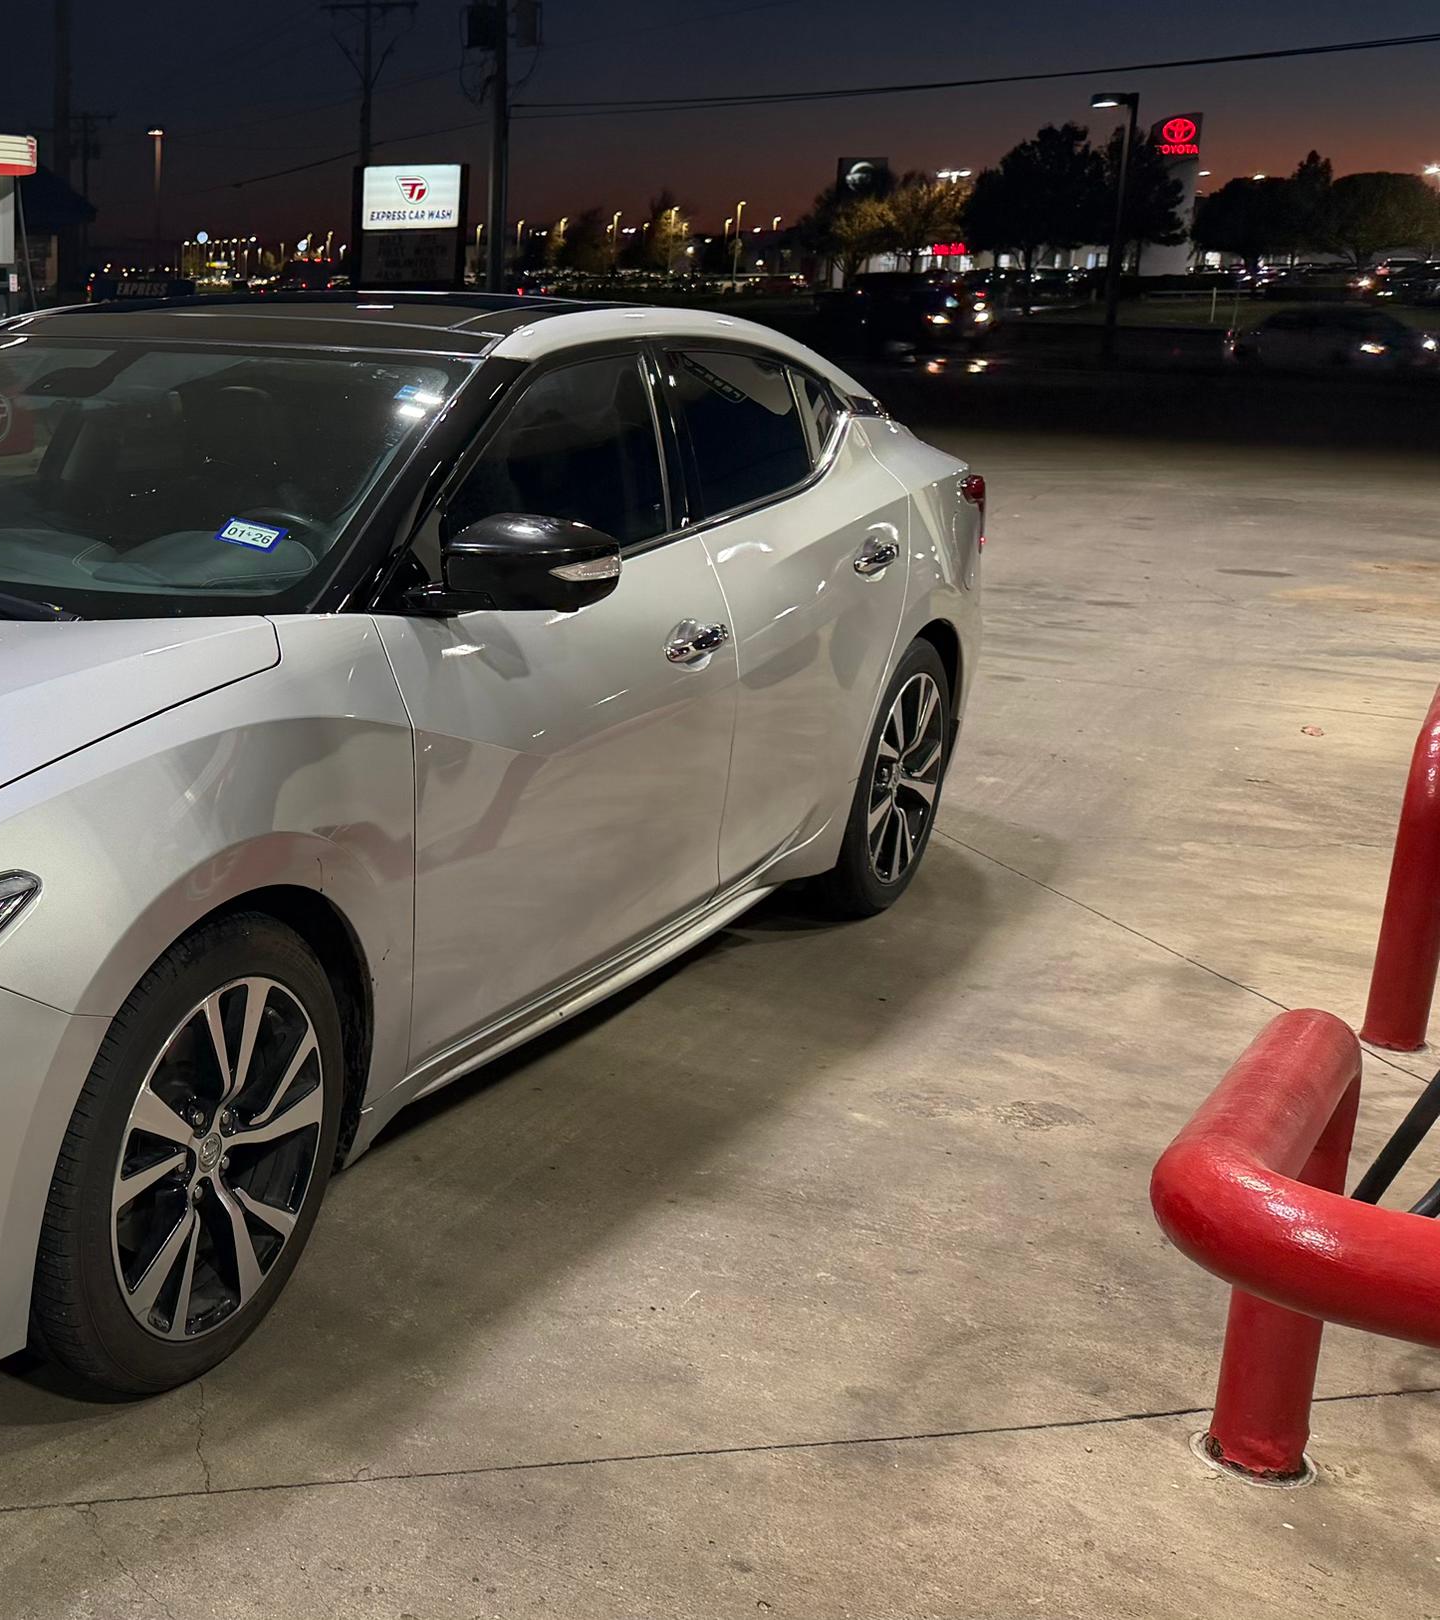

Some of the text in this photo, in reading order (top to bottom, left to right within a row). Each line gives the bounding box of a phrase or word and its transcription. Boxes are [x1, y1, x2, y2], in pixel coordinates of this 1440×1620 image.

[1154, 144, 1199, 155] TOYOTA
[369, 209, 453, 221] EXPRESS CAR WASH
[116, 282, 168, 296] EXPRESS
